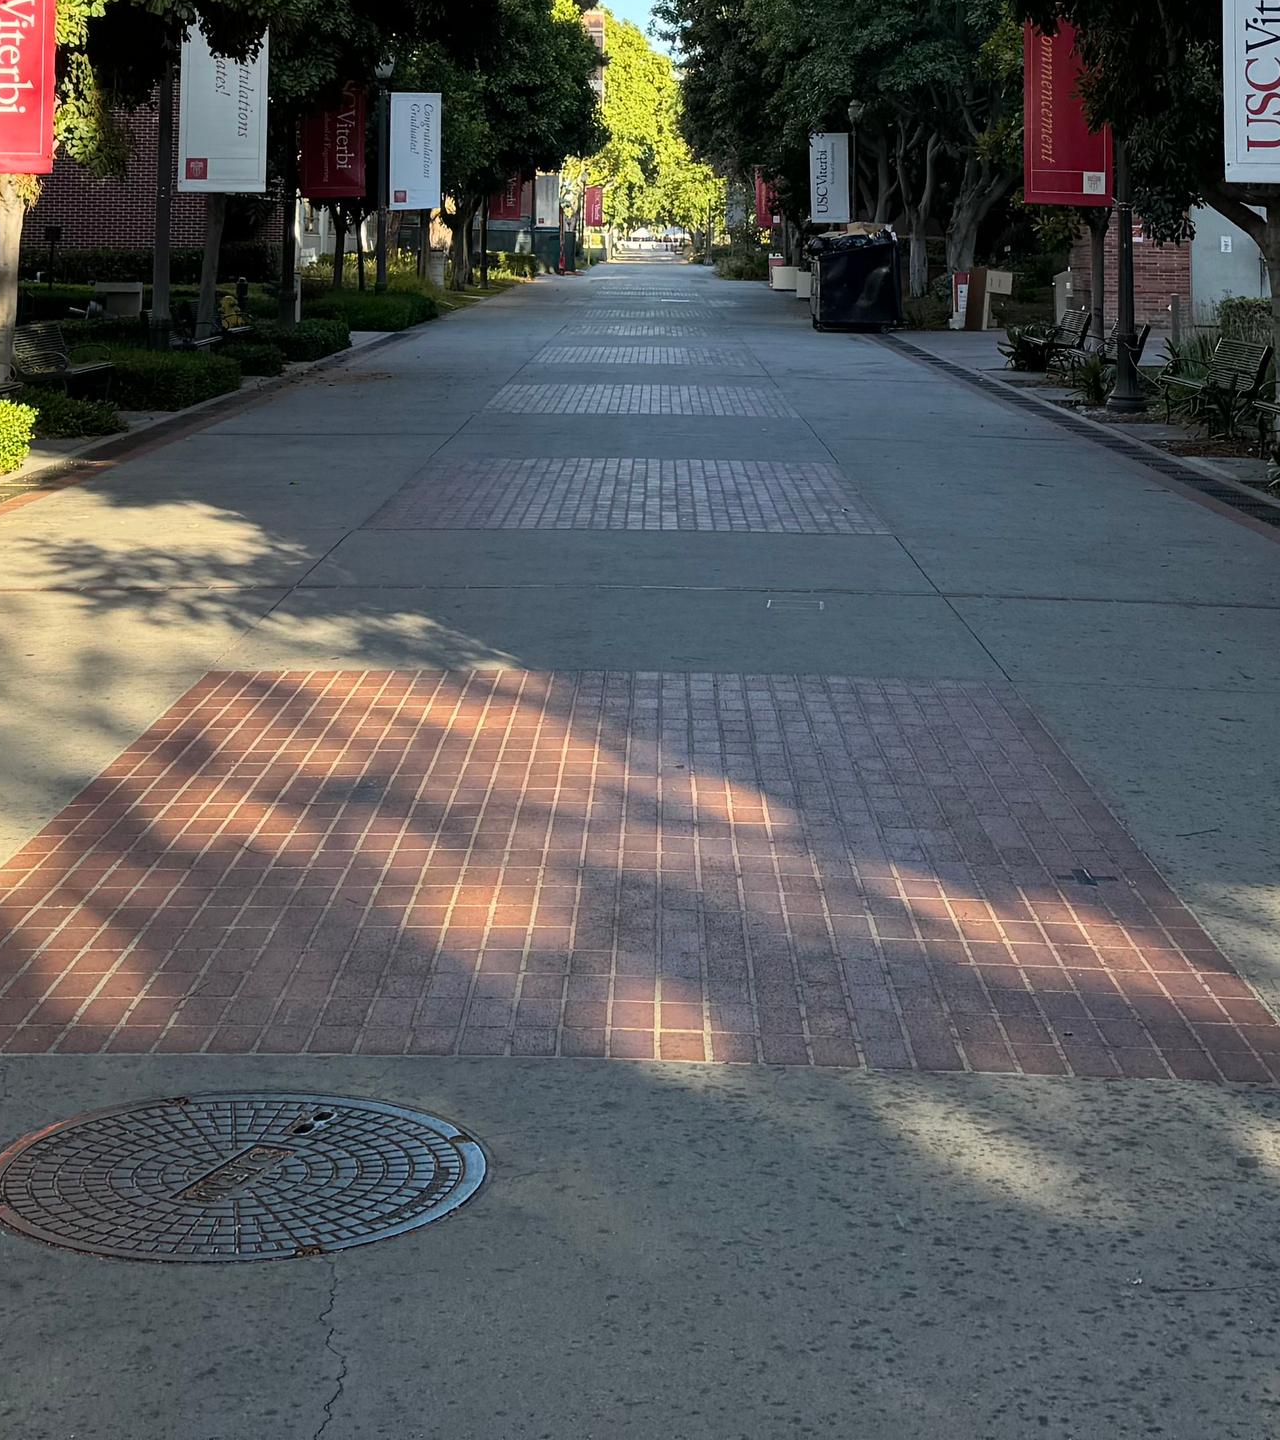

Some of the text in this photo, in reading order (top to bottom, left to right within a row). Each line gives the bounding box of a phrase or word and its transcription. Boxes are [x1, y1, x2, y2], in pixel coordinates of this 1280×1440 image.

[1040, 36, 1056, 163] ommencement
[335, 108, 356, 170] Viterbi
[420, 103, 434, 179] Congratulations
[815, 150, 828, 214] USC Viterbi
